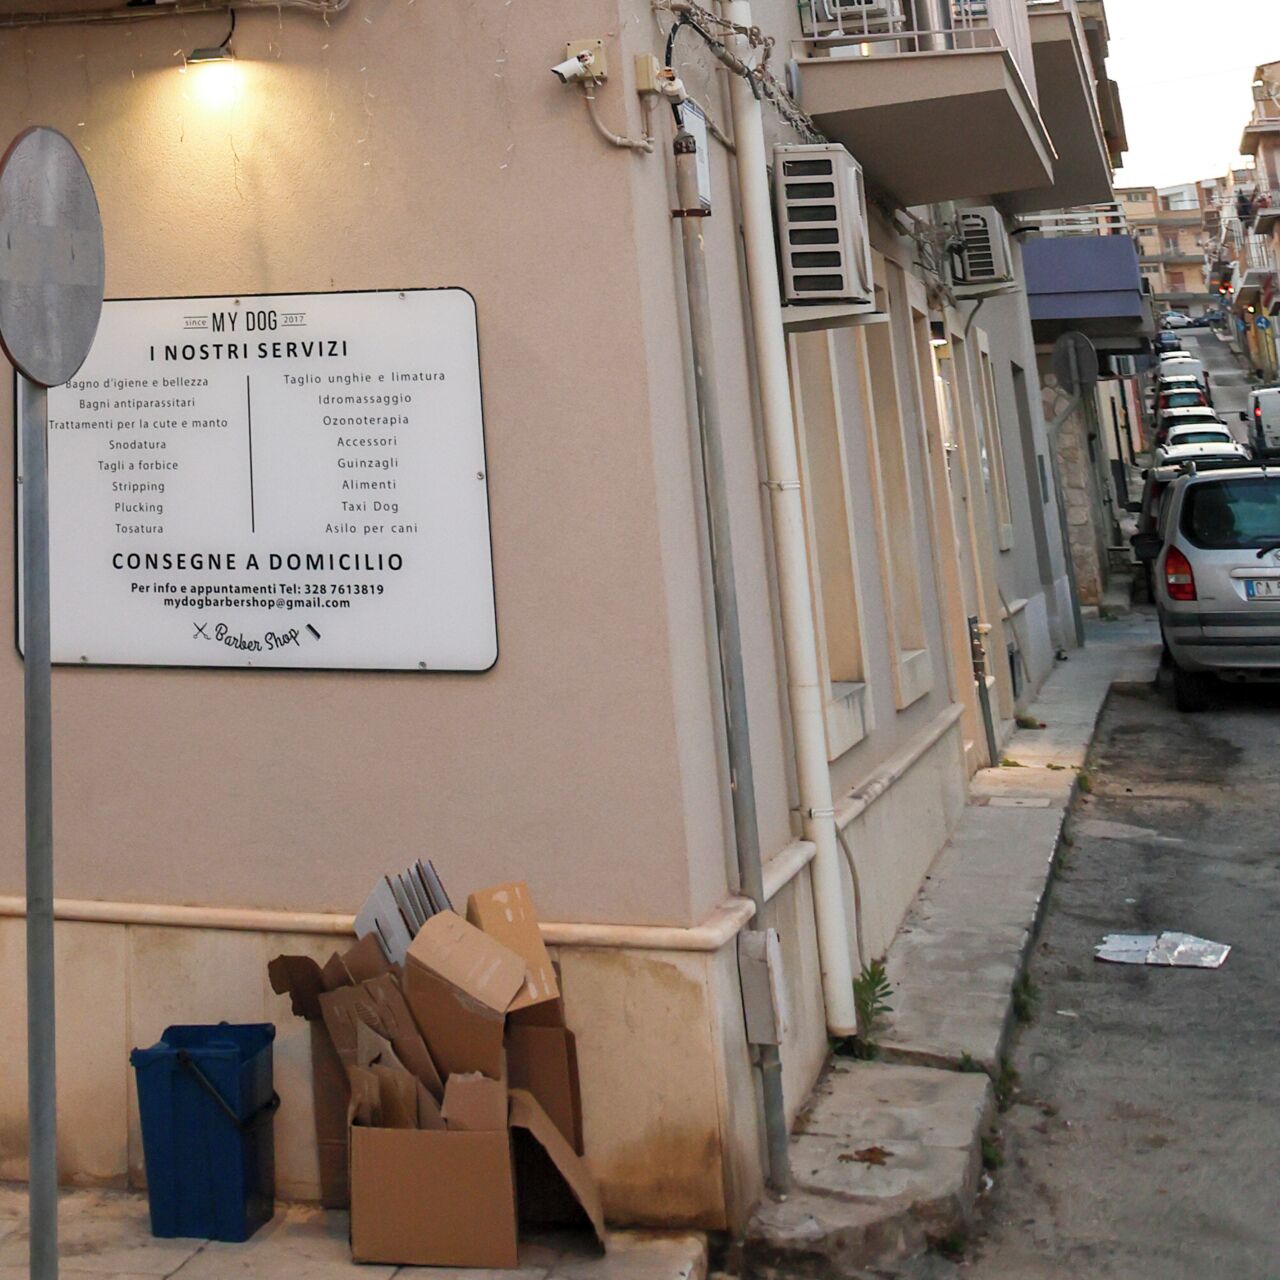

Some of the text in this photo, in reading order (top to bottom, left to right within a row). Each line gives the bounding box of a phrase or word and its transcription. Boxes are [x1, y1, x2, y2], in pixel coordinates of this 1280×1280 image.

[184, 309, 304, 333] since MY DOG 2017
[150, 340, 347, 362] I NOSTRI SERVIZI
[152, 379, 159, 388] e
[162, 376, 209, 388] bellezza
[283, 371, 445, 387] Taglio unghie e limatura
[79, 398, 195, 412] Bagni antiparassitari
[318, 394, 412, 406] Idromassaggio
[48, 418, 228, 431] Trattamenti per la cute e manto
[322, 415, 409, 427] Ozonoterapia
[108, 439, 167, 450] Snodatura
[337, 436, 397, 447] Accessori
[97, 459, 179, 473] Tagli a forbice
[337, 457, 398, 471] Guinzagli
[112, 481, 165, 494] Stripping
[342, 479, 396, 490] Alimenti
[114, 502, 164, 515] Plucking
[341, 500, 399, 514] Taxi Dog
[115, 523, 164, 534] Tosatura
[325, 522, 418, 536] Asilo per cani
[112, 552, 403, 571] CONSEGNE A DOMICILIO
[131, 582, 384, 596] Per info e appuntamenti Tel: 328 7613819
[163, 595, 351, 611] mydogbarbershop@gmail.com
[214, 622, 300, 652] Barber Shop
